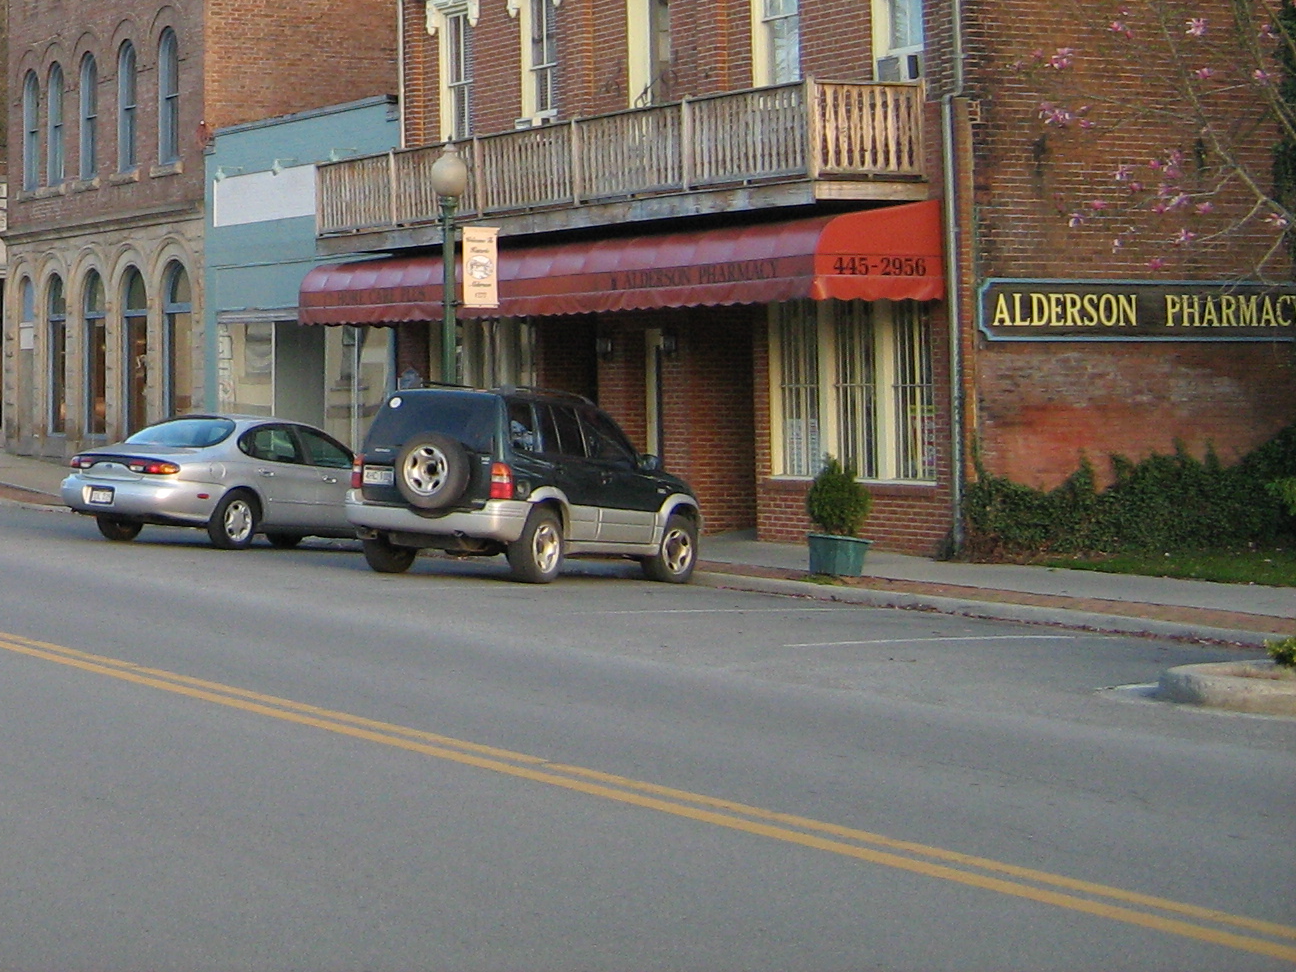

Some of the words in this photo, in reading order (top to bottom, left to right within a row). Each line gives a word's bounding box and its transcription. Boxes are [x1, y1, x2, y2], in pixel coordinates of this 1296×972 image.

[626, 267, 691, 290] ALDERSON
[698, 260, 778, 285] PHARMACY
[833, 257, 927, 277] 445-2956
[992, 292, 1138, 327] ALDERSON
